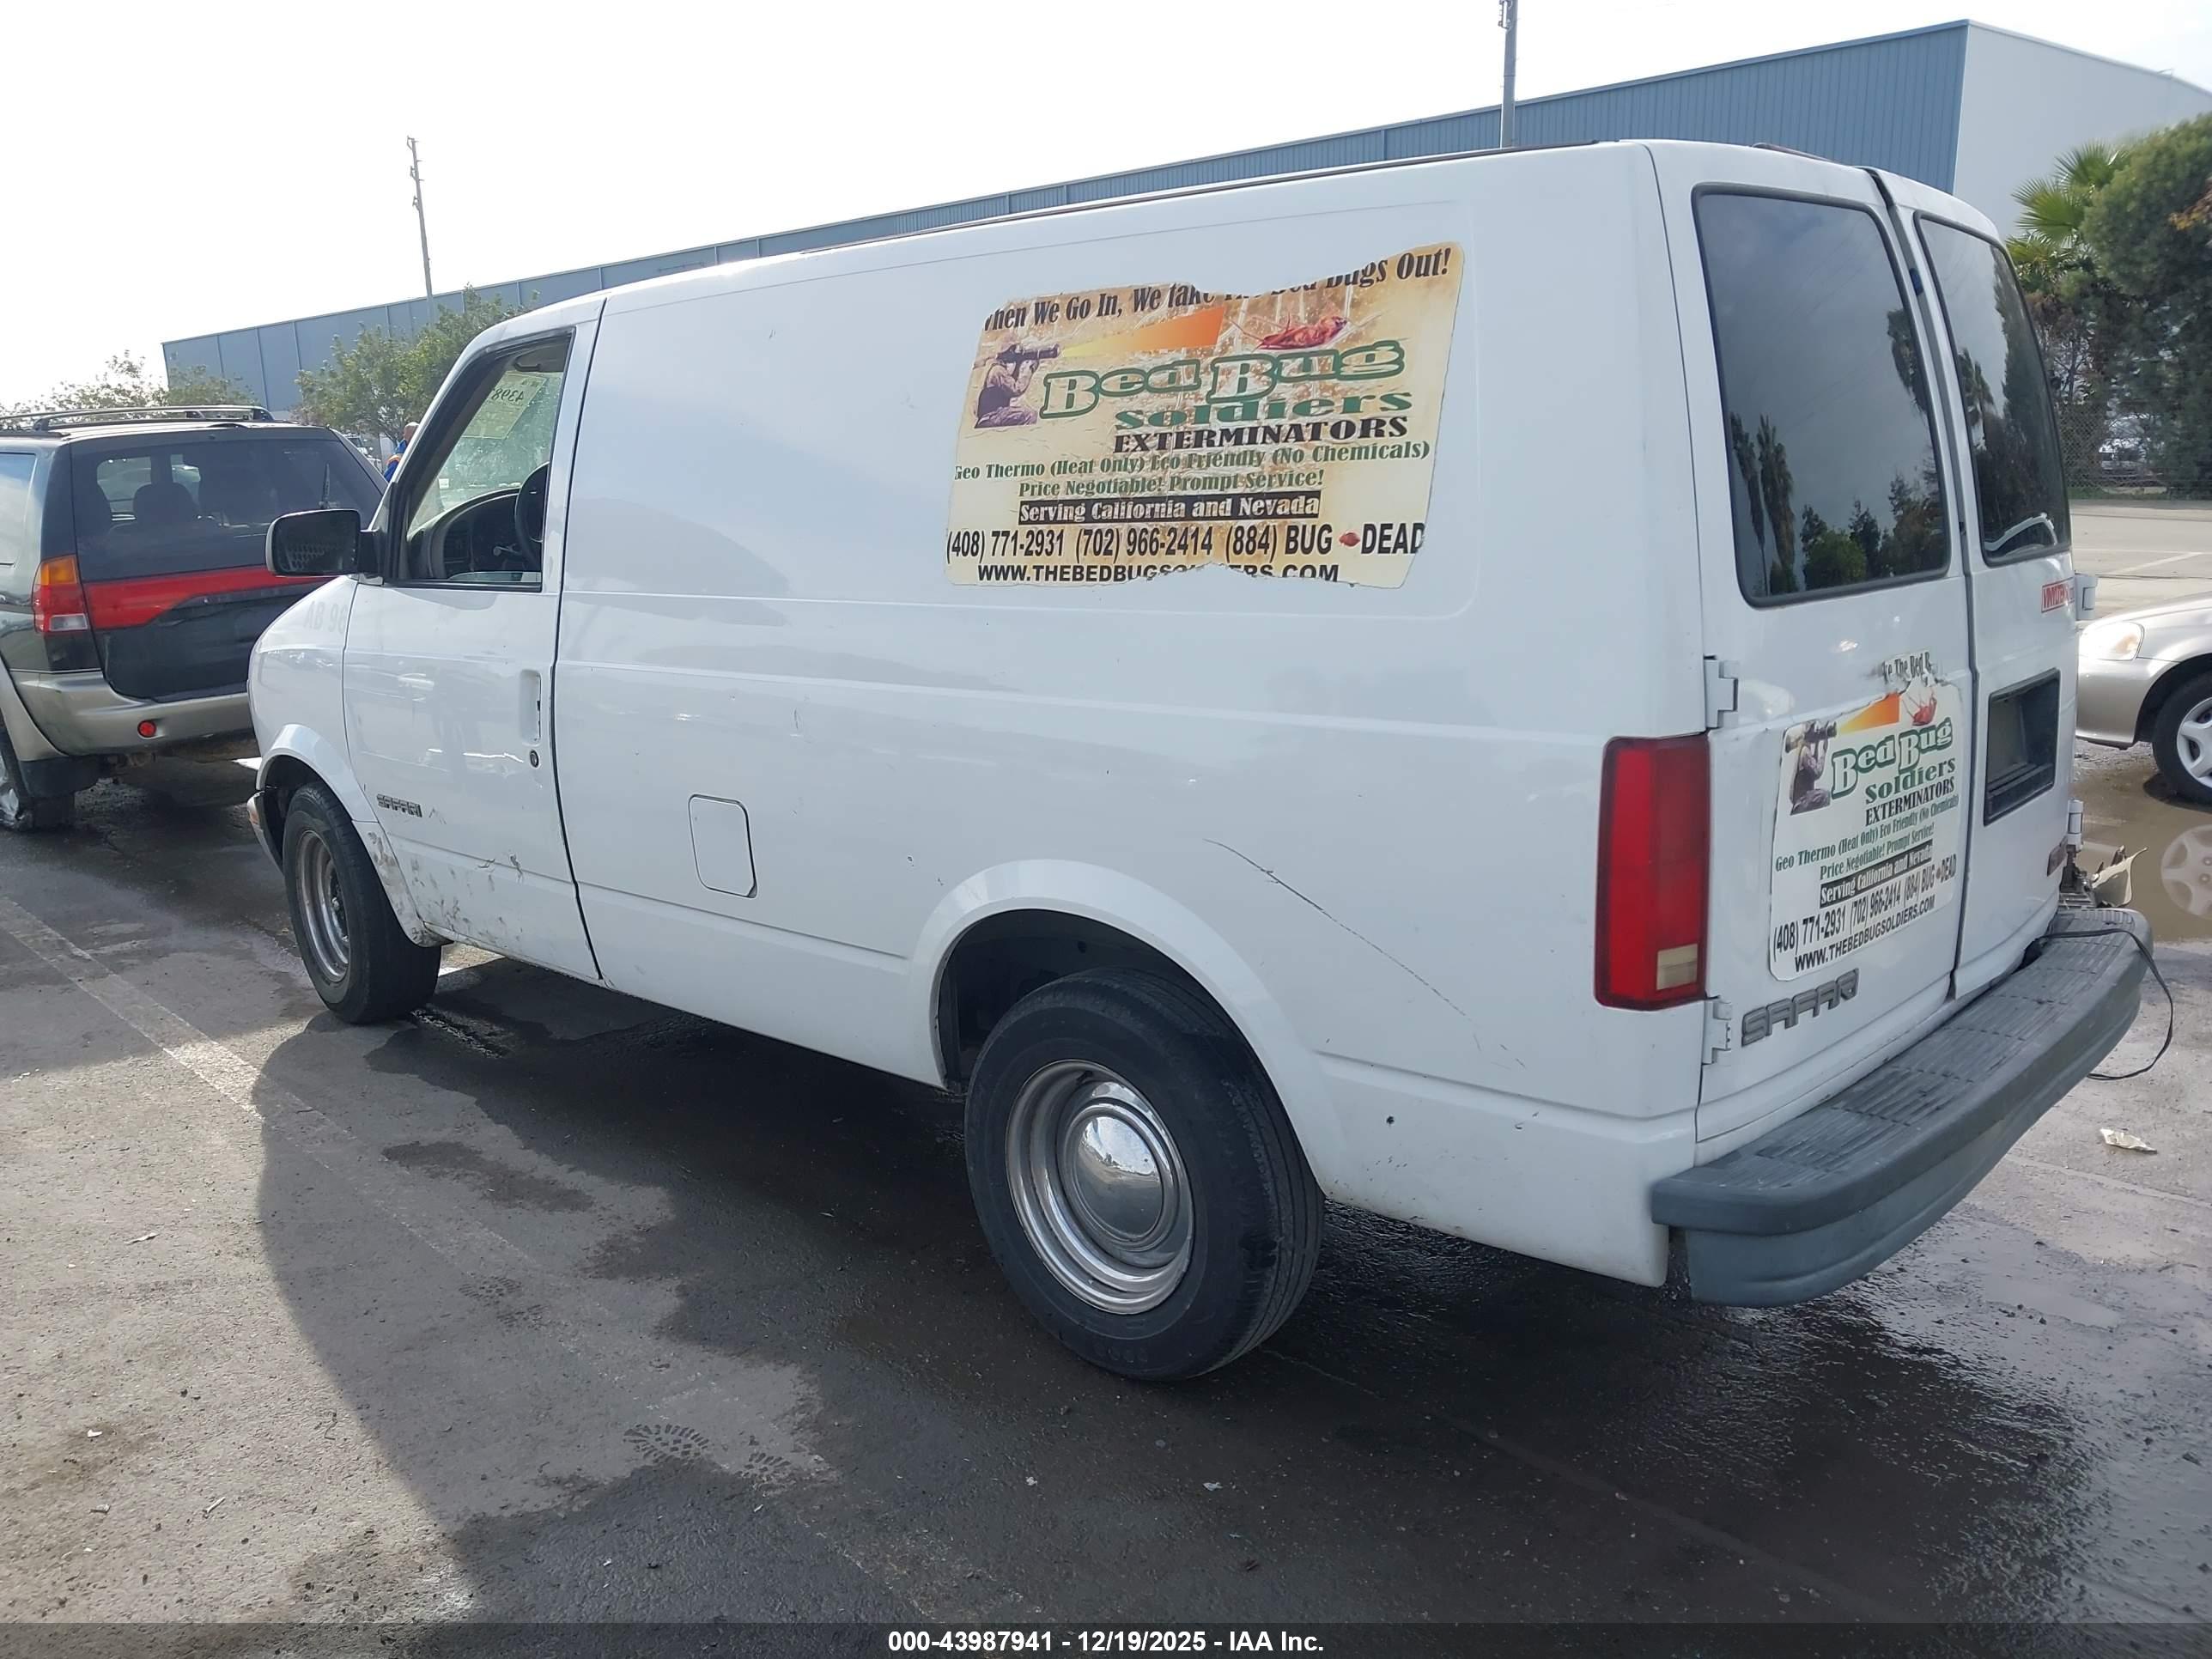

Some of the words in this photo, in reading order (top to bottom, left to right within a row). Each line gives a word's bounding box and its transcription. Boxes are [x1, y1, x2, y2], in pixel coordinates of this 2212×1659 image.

[1034, 301, 1060, 325] We
[1066, 296, 1091, 320] Go
[1097, 293, 1121, 318] In,
[1133, 287, 1161, 313] We
[1397, 247, 1451, 279] Out!
[1039, 359, 1201, 418] Bed
[1206, 340, 1406, 404] Bug
[1113, 416, 1408, 454] EXTERMINATORS
[986, 463, 1045, 478] Thermo
[1050, 459, 1094, 477] (Heat
[1100, 455, 1145, 475] Only)
[1188, 449, 1266, 469] Friendly
[1273, 447, 1304, 465] (No
[1312, 441, 1430, 462] Chemicals)
[1019, 483, 1060, 497] Price
[1066, 476, 1162, 497] Negotiable!
[1170, 472, 1239, 492] Prompt
[1245, 470, 1324, 489] Service!
[1020, 501, 1085, 523] Serving
[1091, 500, 1185, 520] California
[1193, 497, 1231, 517] and
[1238, 495, 1320, 516] Nevada
[946, 529, 986, 564] (408)
[991, 529, 1064, 557] 771-2931
[1076, 527, 1121, 563] (702)
[1127, 526, 1213, 557] 966-2414
[1225, 524, 1278, 563] (884)
[1285, 523, 1333, 555] BUG
[1361, 522, 1425, 555] DEAD
[1832, 735, 1896, 799] Bed
[1899, 717, 1953, 775] Bug
[1866, 776, 1954, 826] EXTERMINATORS
[1776, 855, 1795, 872] Geo
[1798, 844, 1836, 866] Thermo
[1820, 861, 1844, 880] Price
[1846, 842, 1886, 872] Negotiable!
[1821, 877, 1856, 904] Serving
[1774, 920, 1799, 962] (408)
[1802, 905, 1845, 945] 771-2931
[1850, 895, 1868, 935] (702)
